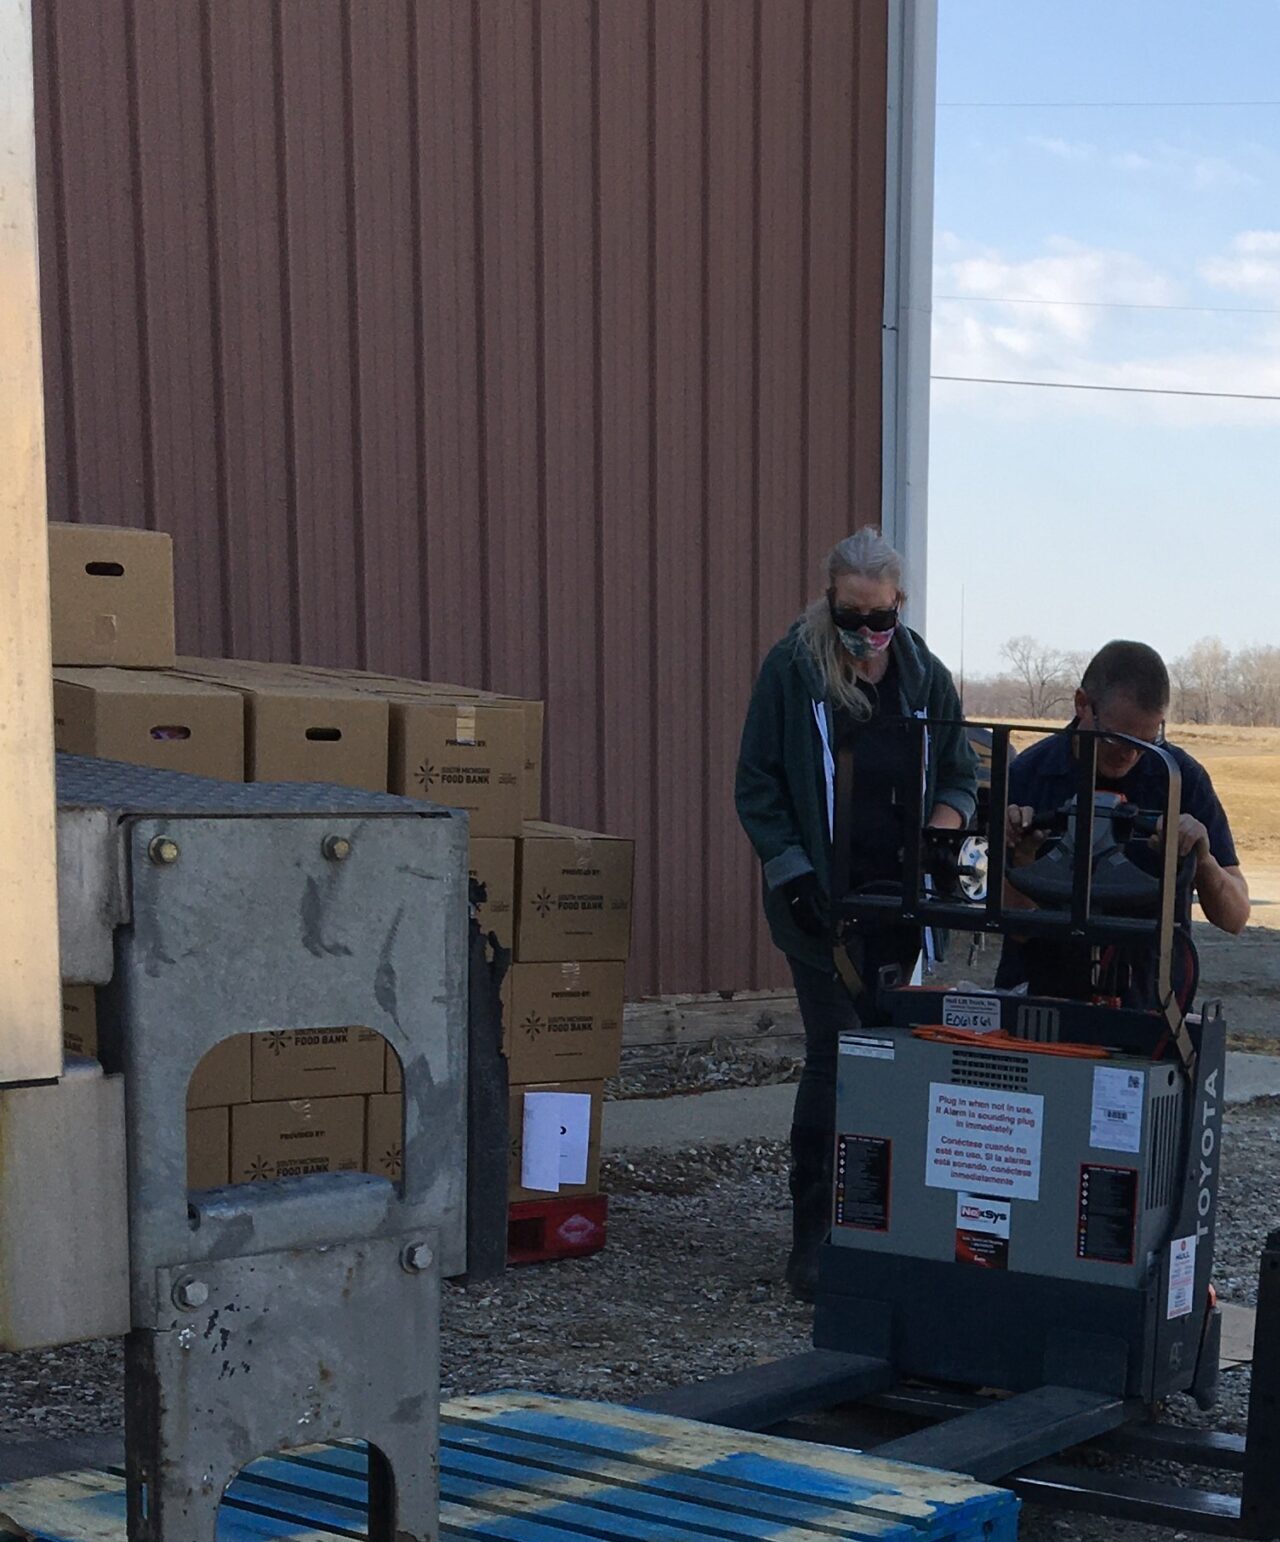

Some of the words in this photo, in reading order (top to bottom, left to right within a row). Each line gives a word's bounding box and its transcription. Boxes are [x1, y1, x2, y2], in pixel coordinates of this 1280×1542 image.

[441, 774, 464, 784] FOOD
[466, 774, 490, 785] BANK
[558, 902, 579, 911] FOOD
[581, 901, 604, 910] BANK
[547, 1024, 569, 1033] FOOD
[570, 1022, 593, 1032] BANK
[294, 1035, 320, 1047] FOOD
[322, 1034, 348, 1045] BANK
[939, 1095, 956, 1106] Plug
[958, 1098, 966, 1106] in
[968, 1099, 989, 1109] when
[991, 1102, 1006, 1110] not
[1006, 1104, 1015, 1112] in
[1016, 1106, 1033, 1114] use.
[943, 1107, 967, 1117] Alarm
[968, 1110, 976, 1118] is
[977, 1112, 1015, 1124] sounding
[1016, 1117, 1035, 1127] plug
[956, 1119, 964, 1127] in
[965, 1120, 1013, 1135] immediately
[984, 1143, 1015, 1153] cuando
[1016, 1146, 1027, 1154] no
[953, 1149, 964, 1157] en
[984, 1152, 993, 1161] Si
[994, 1154, 1002, 1162] la
[1004, 1156, 1031, 1166] alarma
[1196, 1067, 1219, 1246] TOYOTA
[276, 1166, 301, 1177] FOOD
[303, 1164, 329, 1176] BANK
